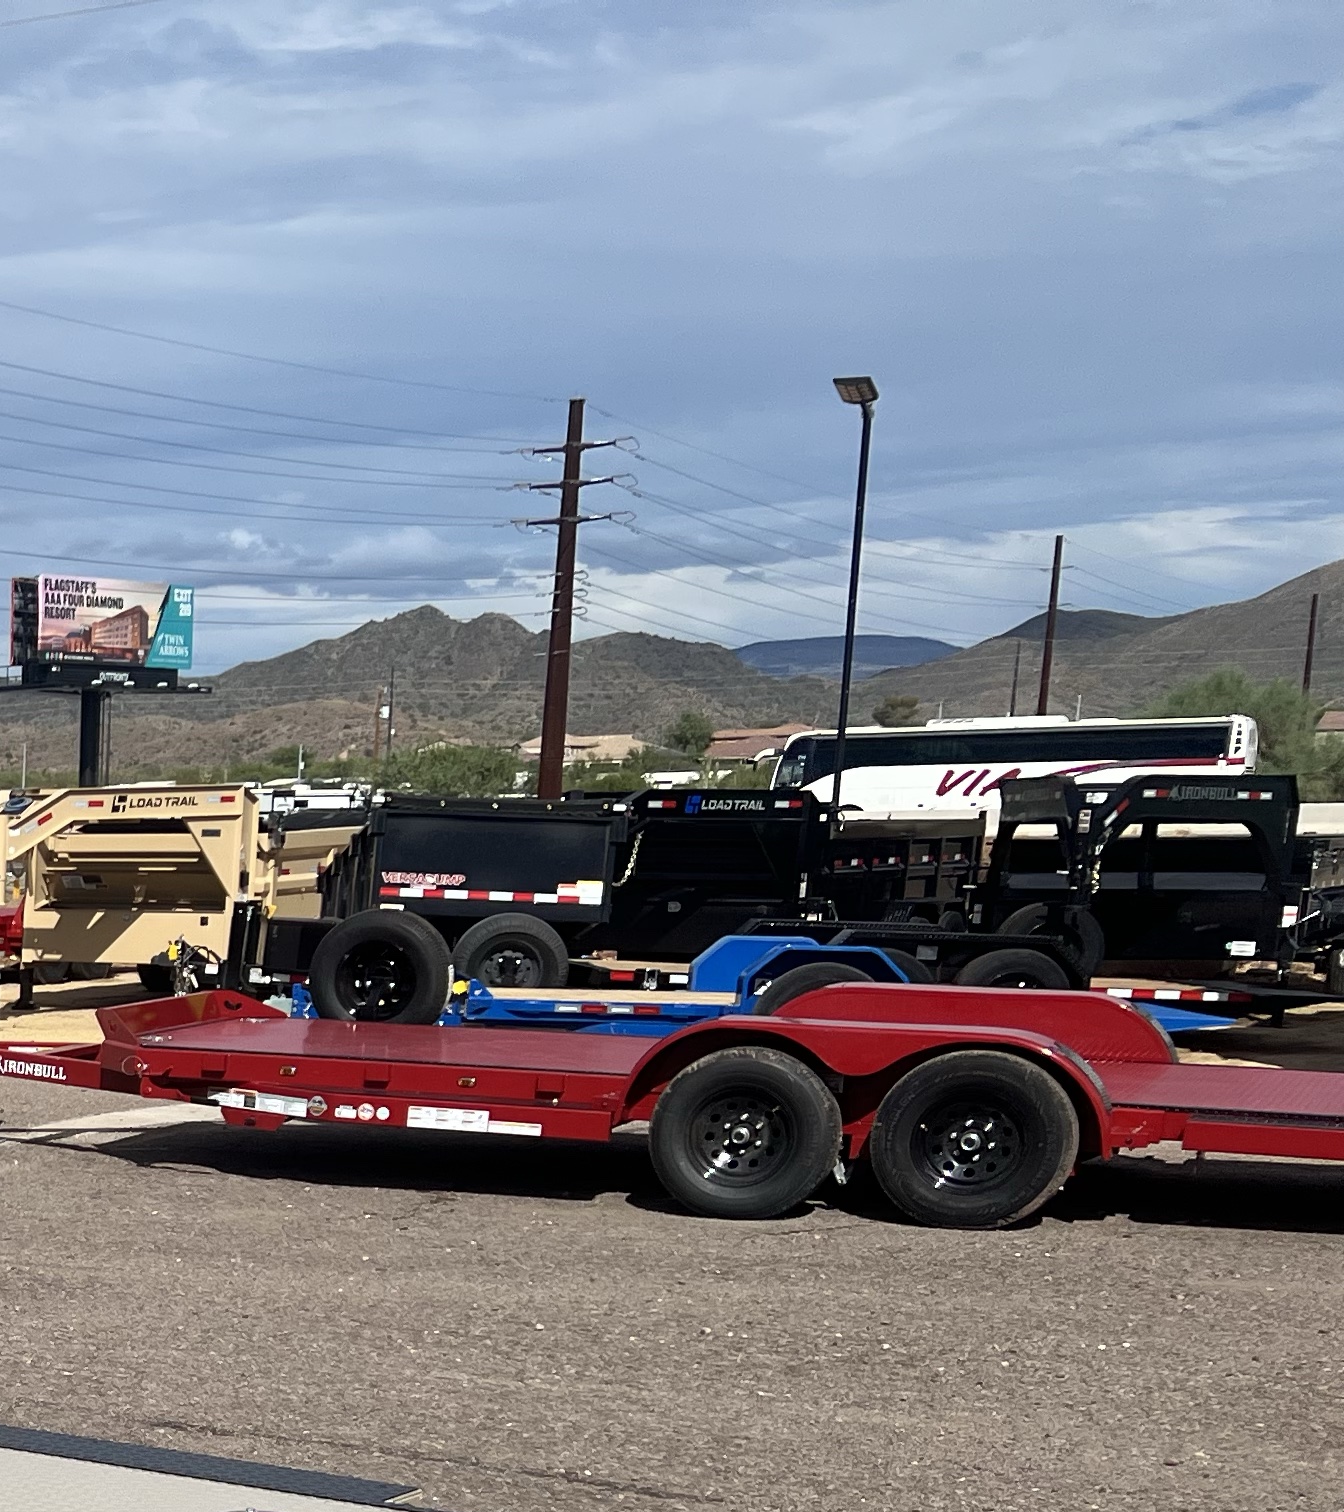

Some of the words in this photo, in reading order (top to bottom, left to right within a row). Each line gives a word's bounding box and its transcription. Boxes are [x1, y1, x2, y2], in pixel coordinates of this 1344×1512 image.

[45, 592, 61, 605] AAA
[63, 594, 84, 607] FOUR
[86, 595, 124, 609] DIAMOND
[44, 607, 76, 620] RESORT
[164, 634, 184, 645] TWIN
[4, 1059, 67, 1080] IRONBULL
